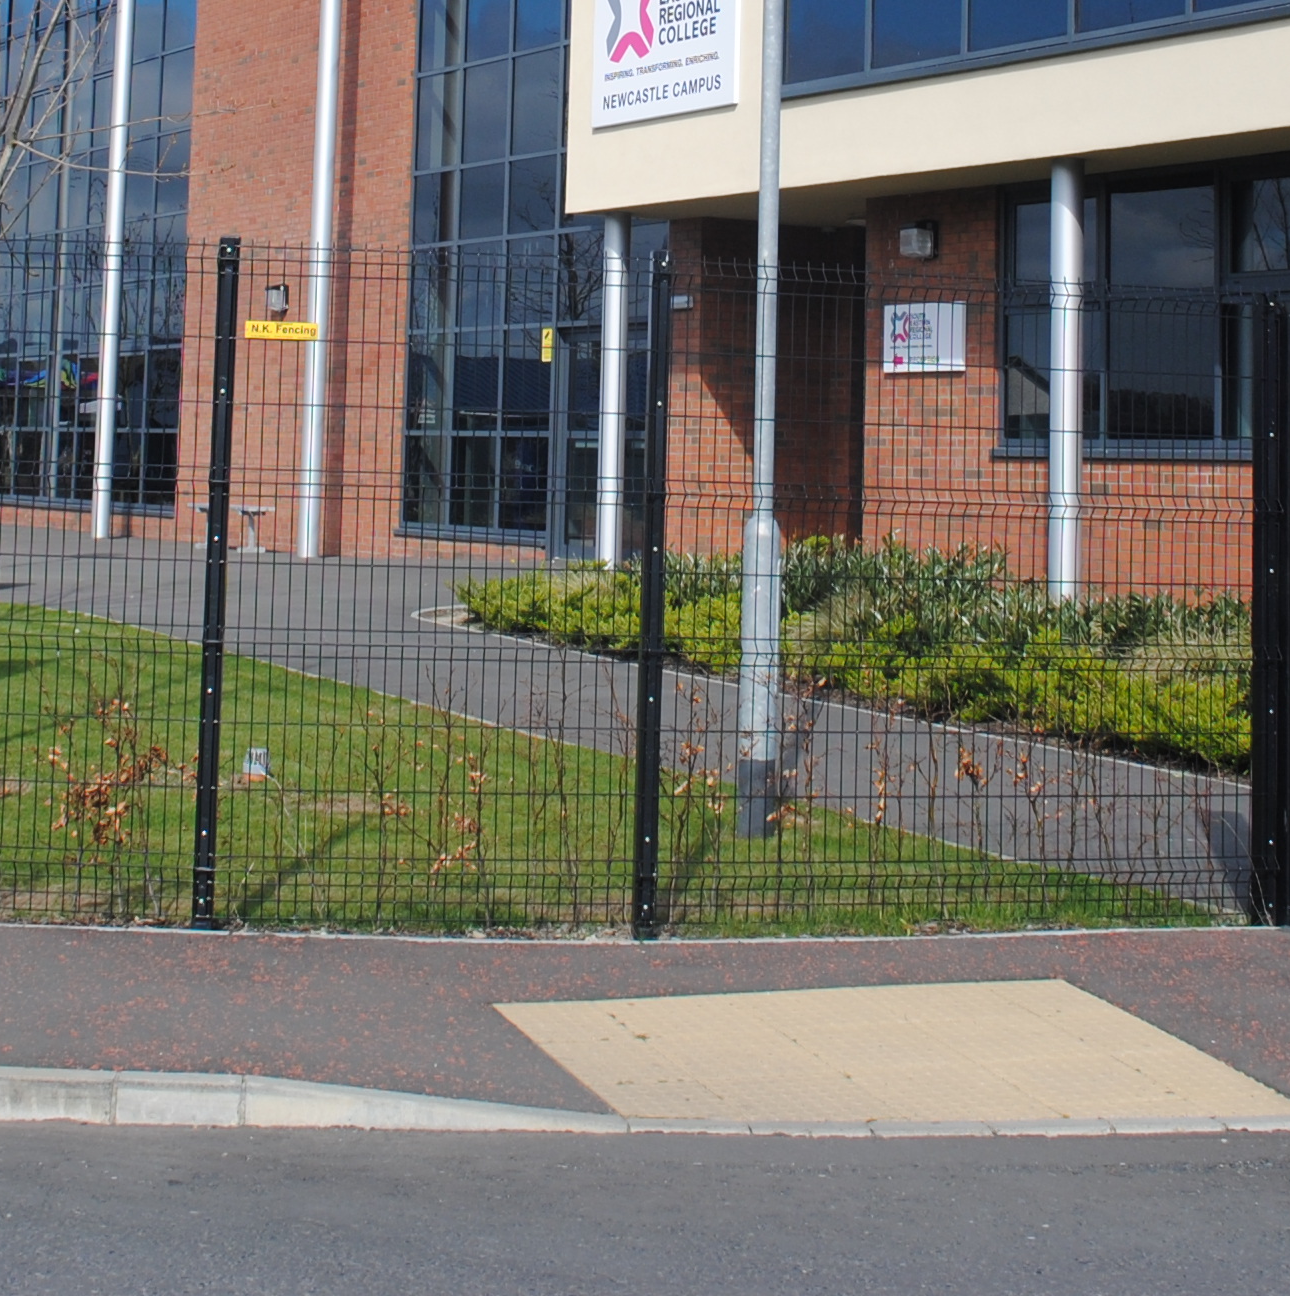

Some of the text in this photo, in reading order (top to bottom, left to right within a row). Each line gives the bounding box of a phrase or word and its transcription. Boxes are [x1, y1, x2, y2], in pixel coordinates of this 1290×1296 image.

[658, 16, 717, 45] COLLEGE
[602, 74, 722, 111] NEWCASTLE CAMPUS
[250, 323, 273, 334] N.K.
[275, 324, 317, 337] Fencing
